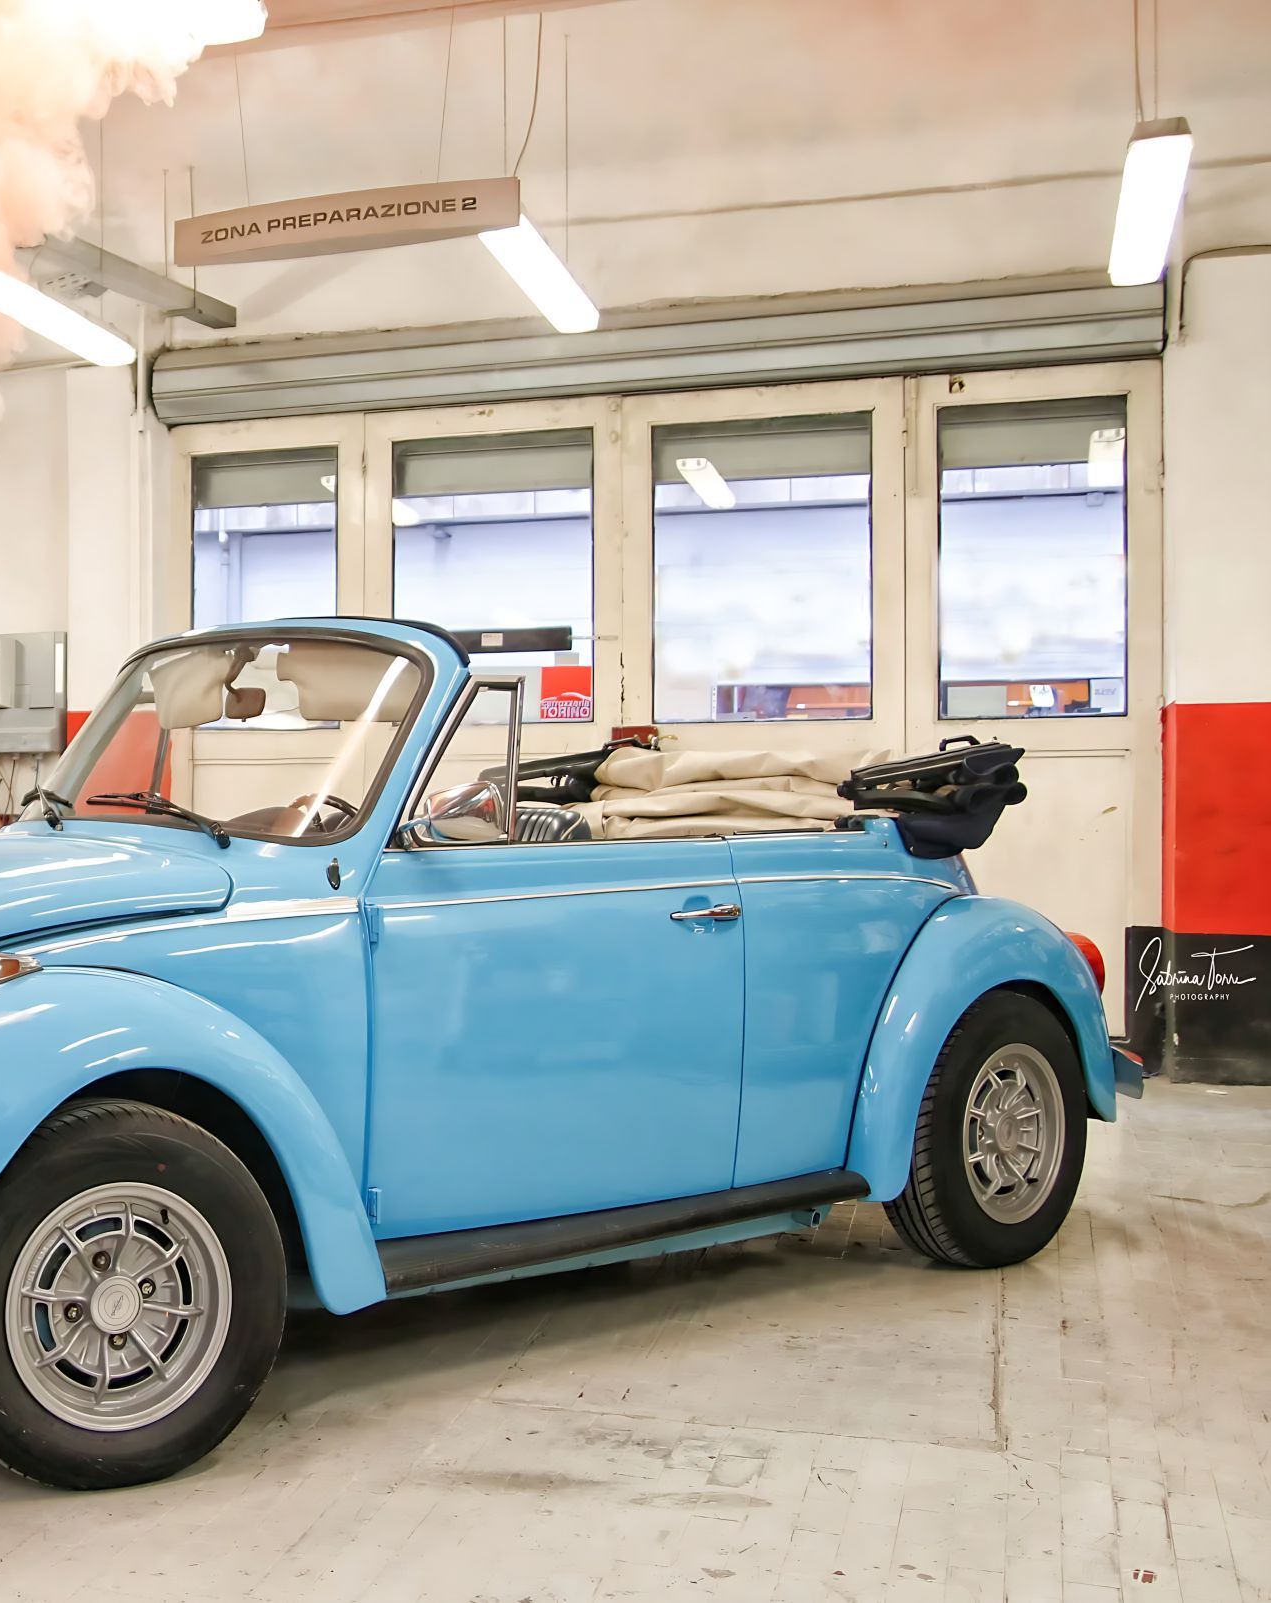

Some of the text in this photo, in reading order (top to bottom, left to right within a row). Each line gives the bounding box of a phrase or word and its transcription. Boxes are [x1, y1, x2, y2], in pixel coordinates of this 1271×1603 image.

[200, 196, 478, 244] ZONA PREPARAZIONE 2
[541, 706, 590, 718] TORINO
